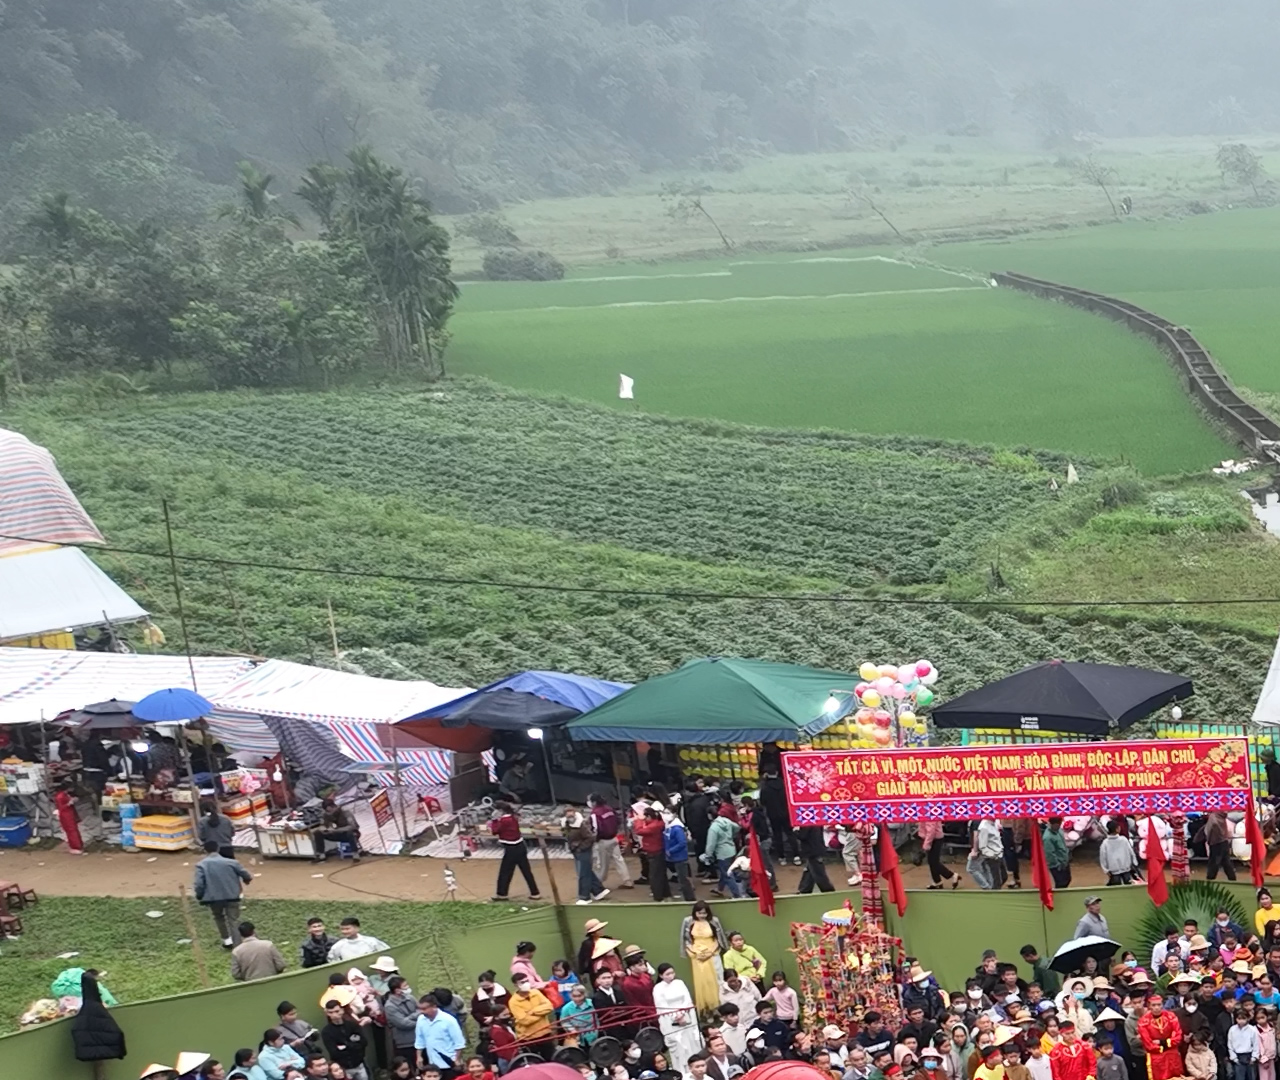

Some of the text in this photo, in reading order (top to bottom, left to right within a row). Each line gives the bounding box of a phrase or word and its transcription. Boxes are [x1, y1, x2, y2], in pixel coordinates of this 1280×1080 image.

[835, 745, 1199, 776] TẤT CẢ VÌ MỘT NƯỚC VIỆT NAM HÒA BÌNH, ĐỘC LẬP, DÂN CHỦ,
[876, 778, 906, 796] GIÀU
[908, 779, 950, 798] MẠNH,
[989, 777, 1023, 793] VINH,
[1024, 773, 1050, 791] VĂN
[1052, 774, 1089, 790] MINH,
[1091, 773, 1125, 792] HẠNH
[1128, 770, 1166, 788] PHÚC!
